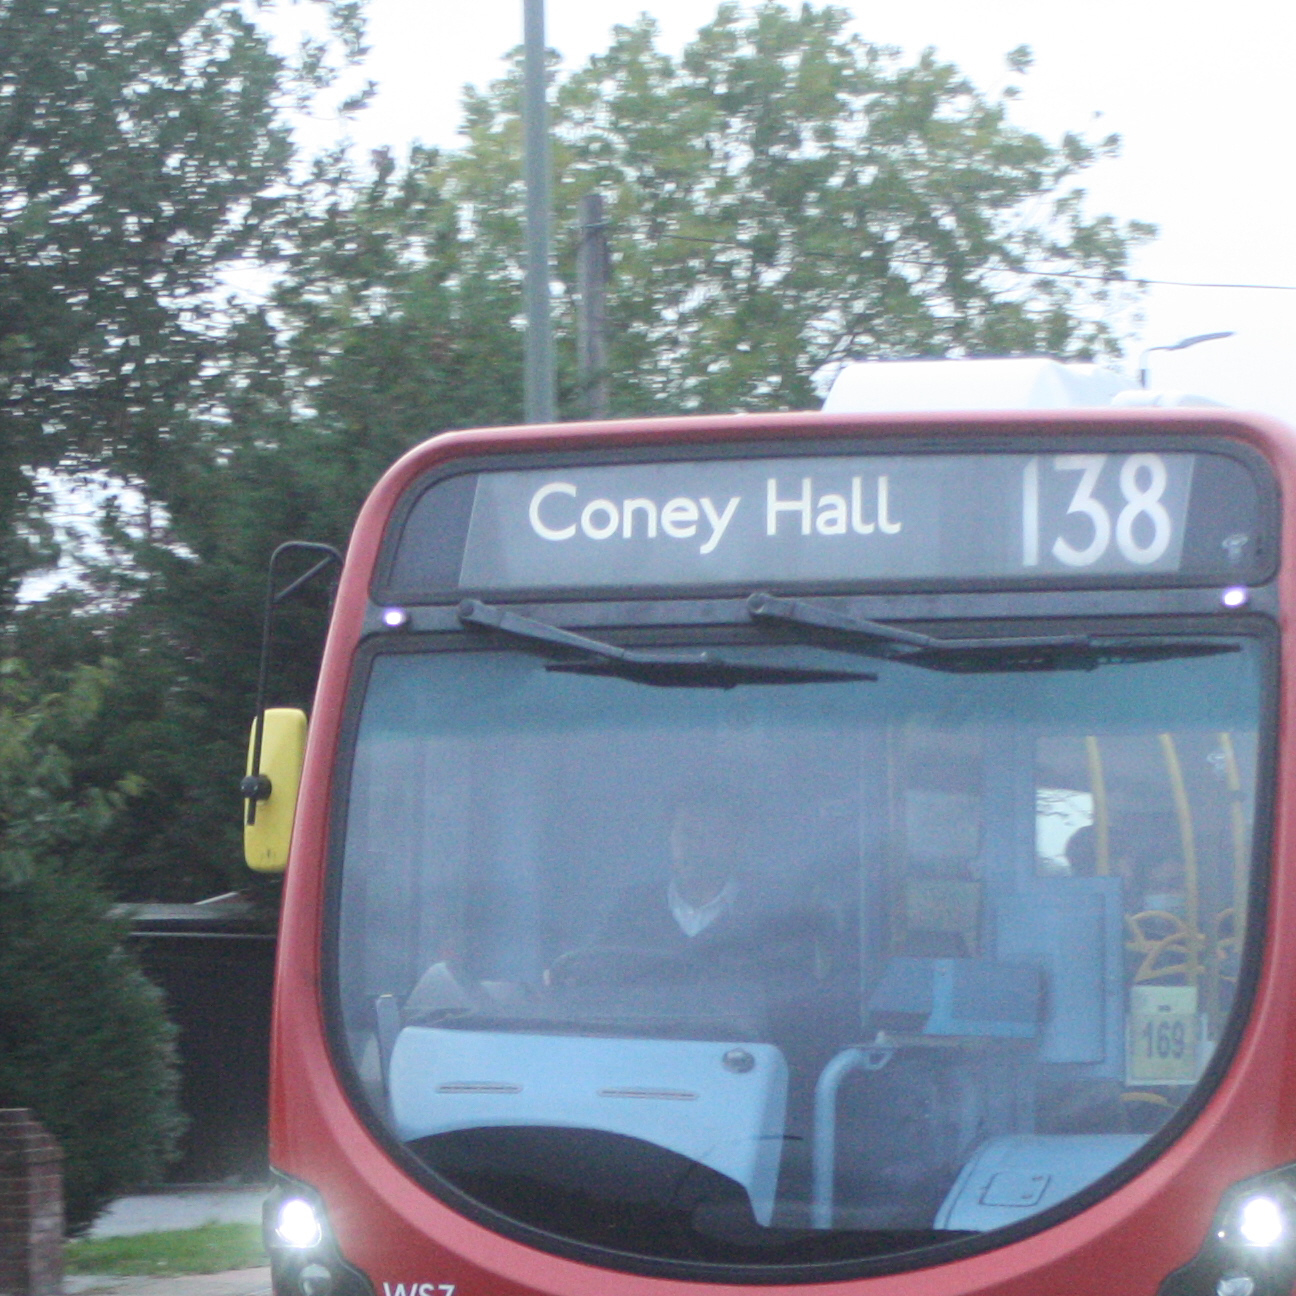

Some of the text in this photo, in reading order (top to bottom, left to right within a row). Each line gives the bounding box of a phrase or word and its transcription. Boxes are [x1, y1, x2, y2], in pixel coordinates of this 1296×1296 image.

[529, 475, 902, 555] Coney Hall
[1022, 453, 1172, 567] 138
